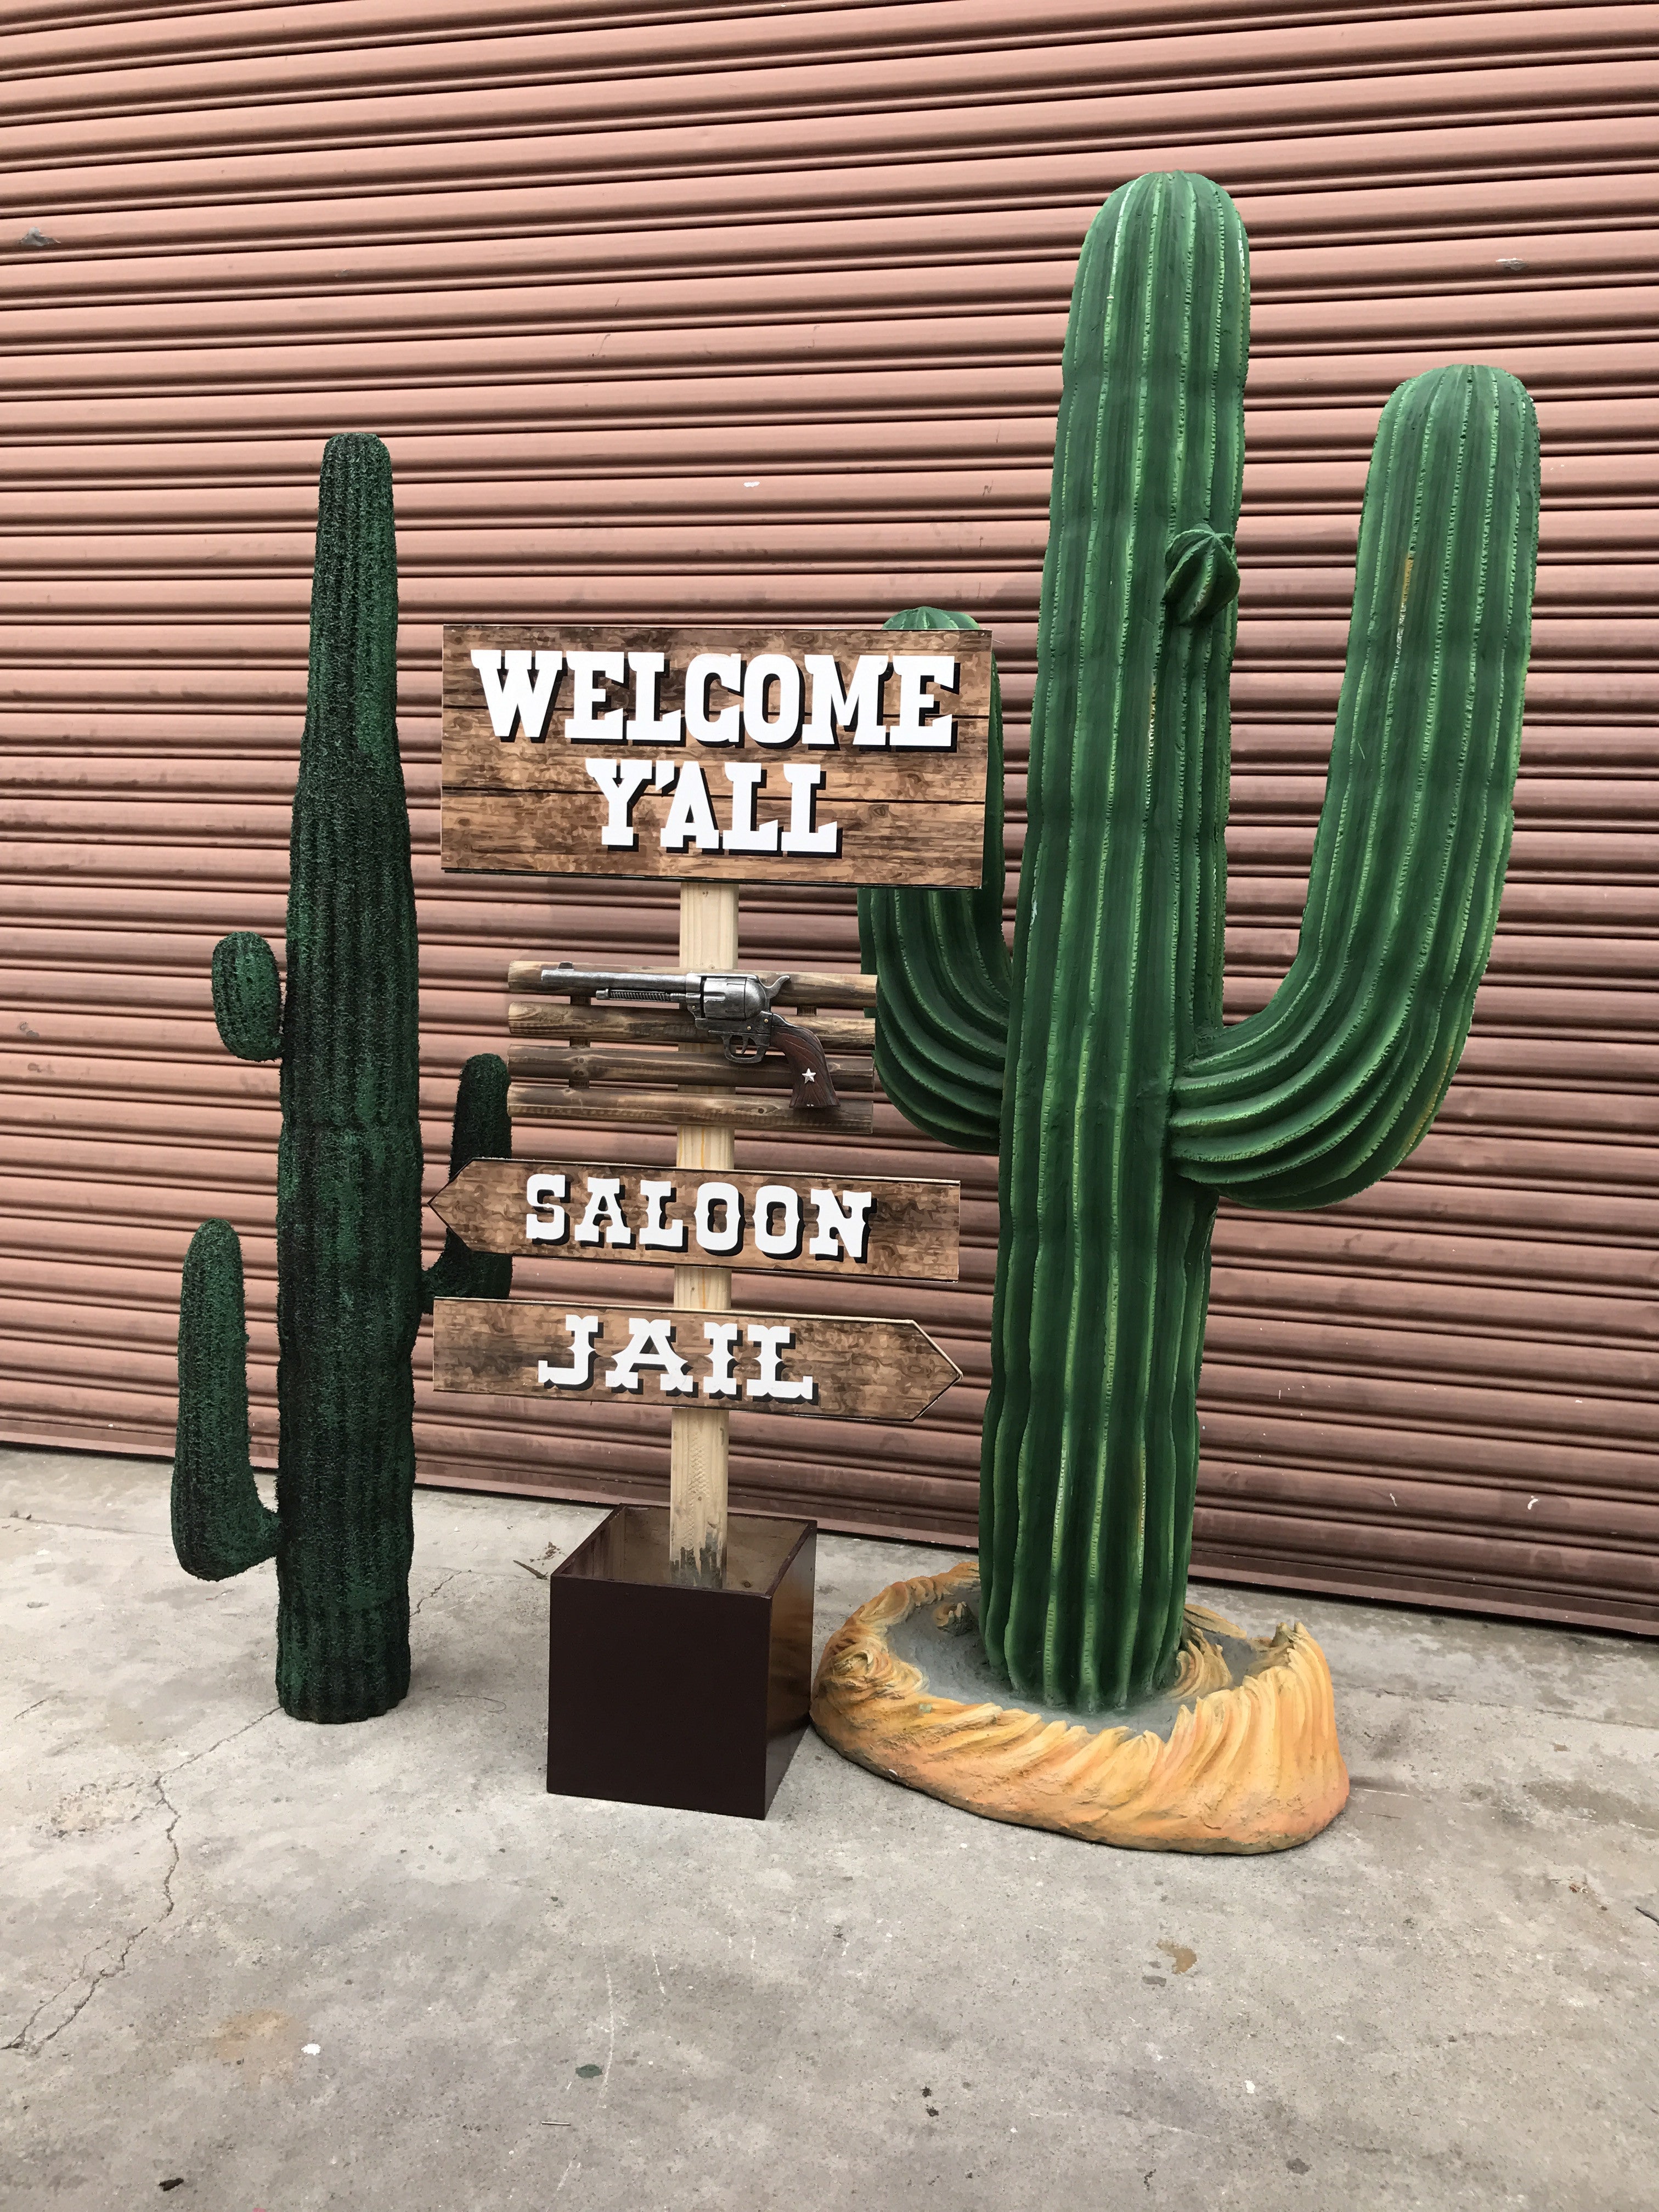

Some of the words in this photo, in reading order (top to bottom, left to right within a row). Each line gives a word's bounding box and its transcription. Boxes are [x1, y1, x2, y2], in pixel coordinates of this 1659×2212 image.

[471, 650, 958, 752] WELCOME
[585, 758, 842, 859] Y'ALL
[526, 1174, 877, 1263] SALOON
[538, 1314, 818, 1404] JAIL
